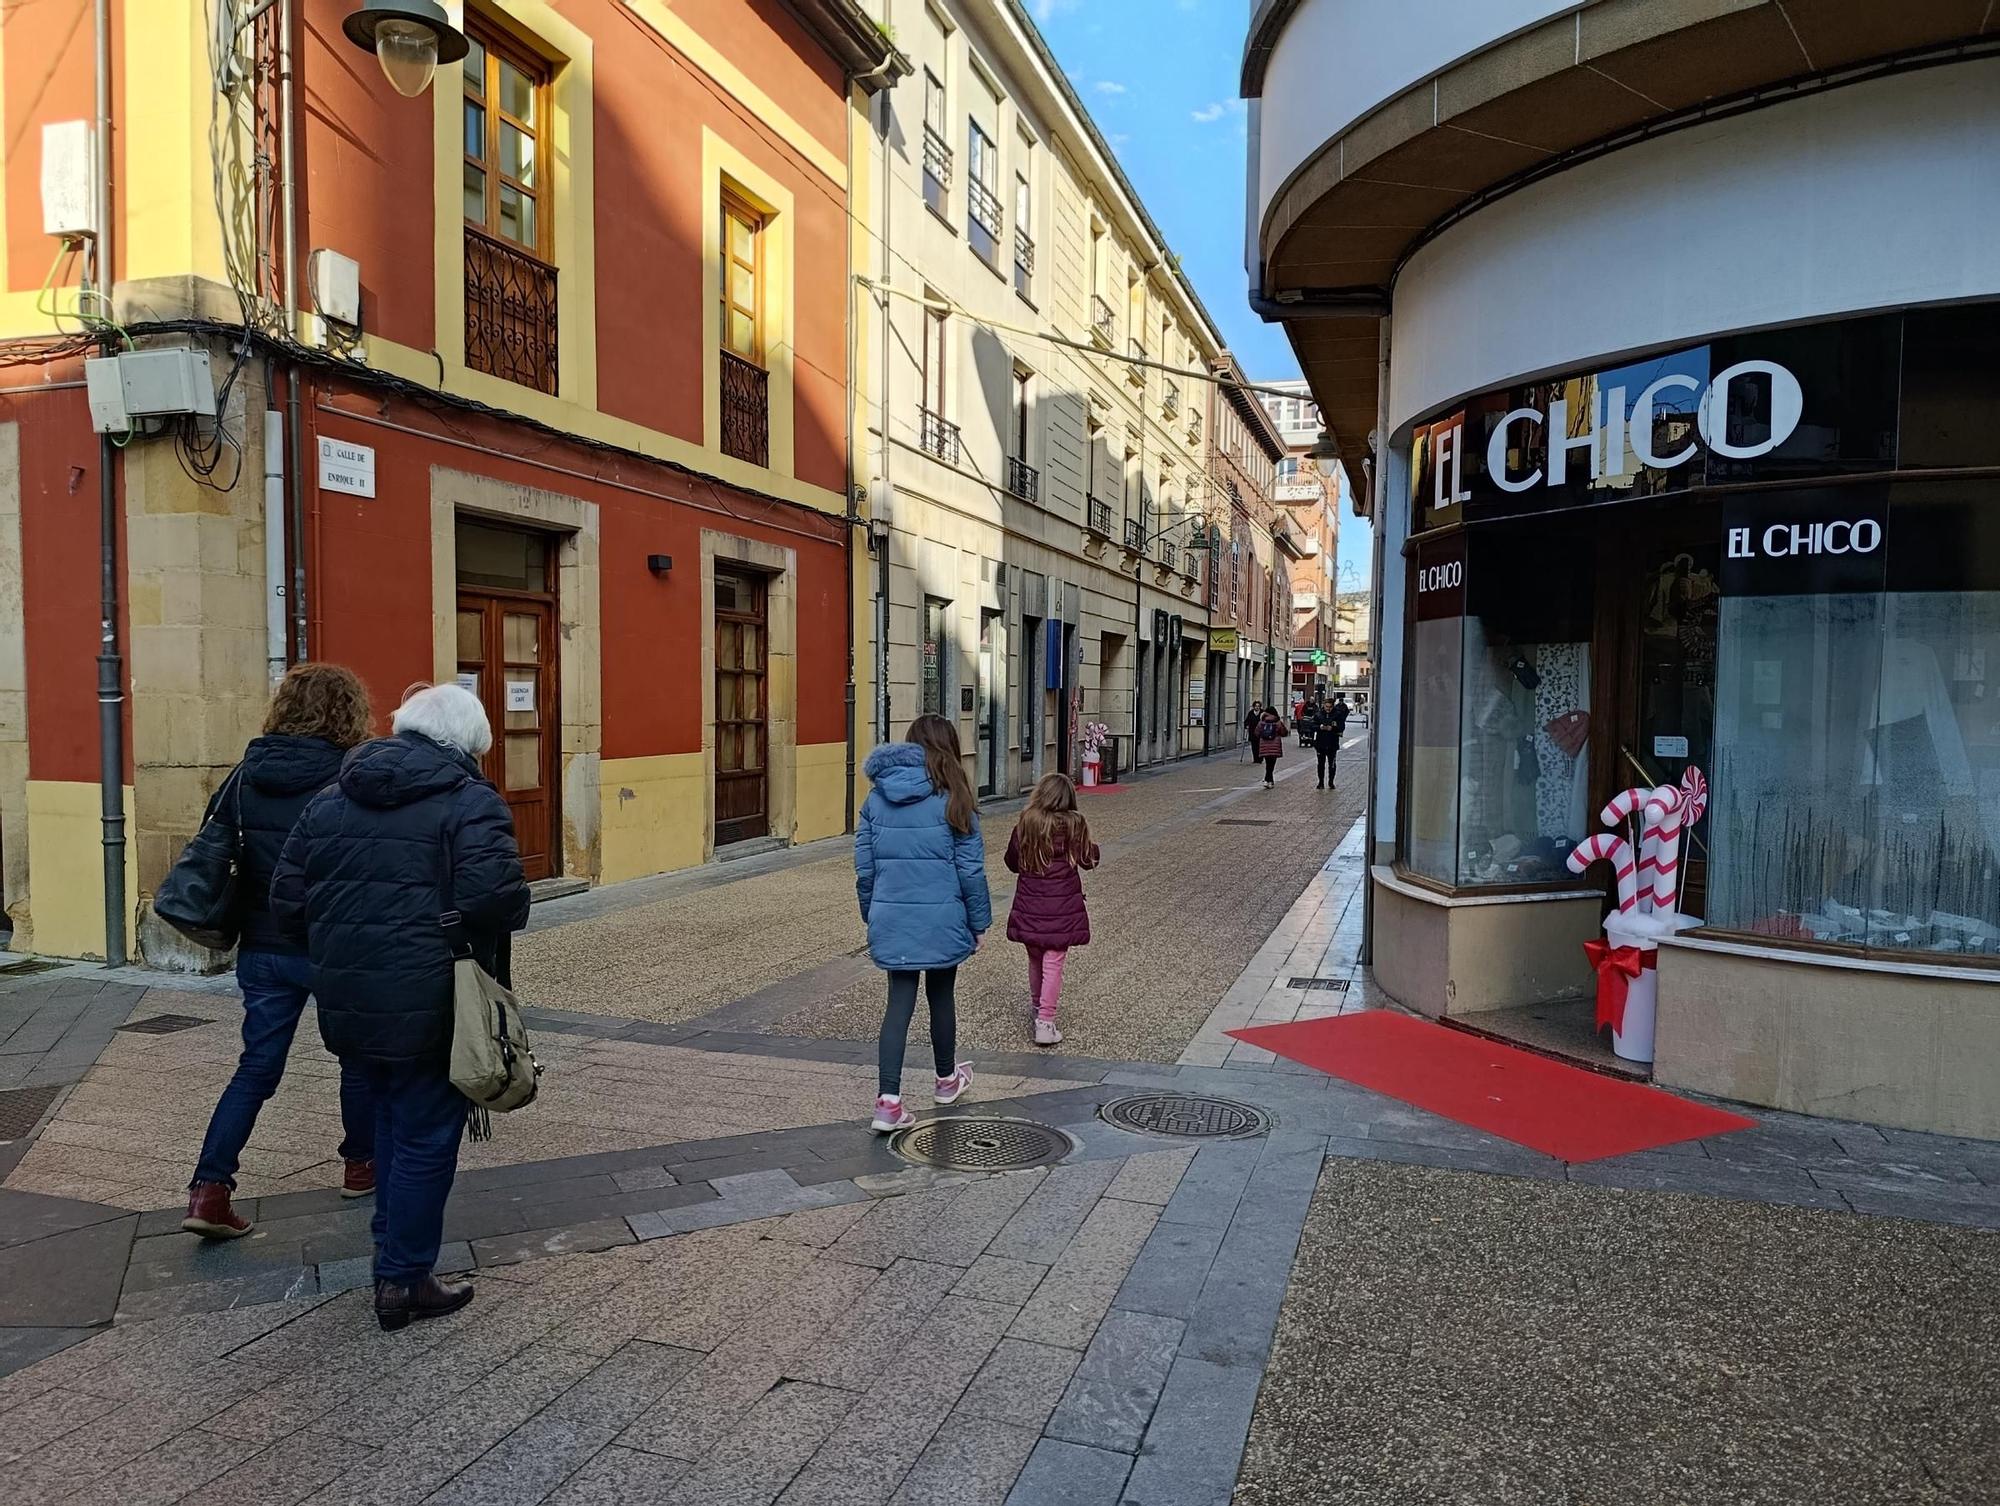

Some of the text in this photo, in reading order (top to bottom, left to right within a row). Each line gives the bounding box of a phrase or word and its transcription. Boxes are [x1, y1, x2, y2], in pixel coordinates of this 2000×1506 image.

[1434, 360, 1803, 511] EL CHICO
[337, 449, 365, 463] CALLE DE
[328, 472, 365, 488] ENRIQUE II
[1728, 519, 1882, 559] EL CHICO
[1419, 560, 1462, 592] EL CHICO
